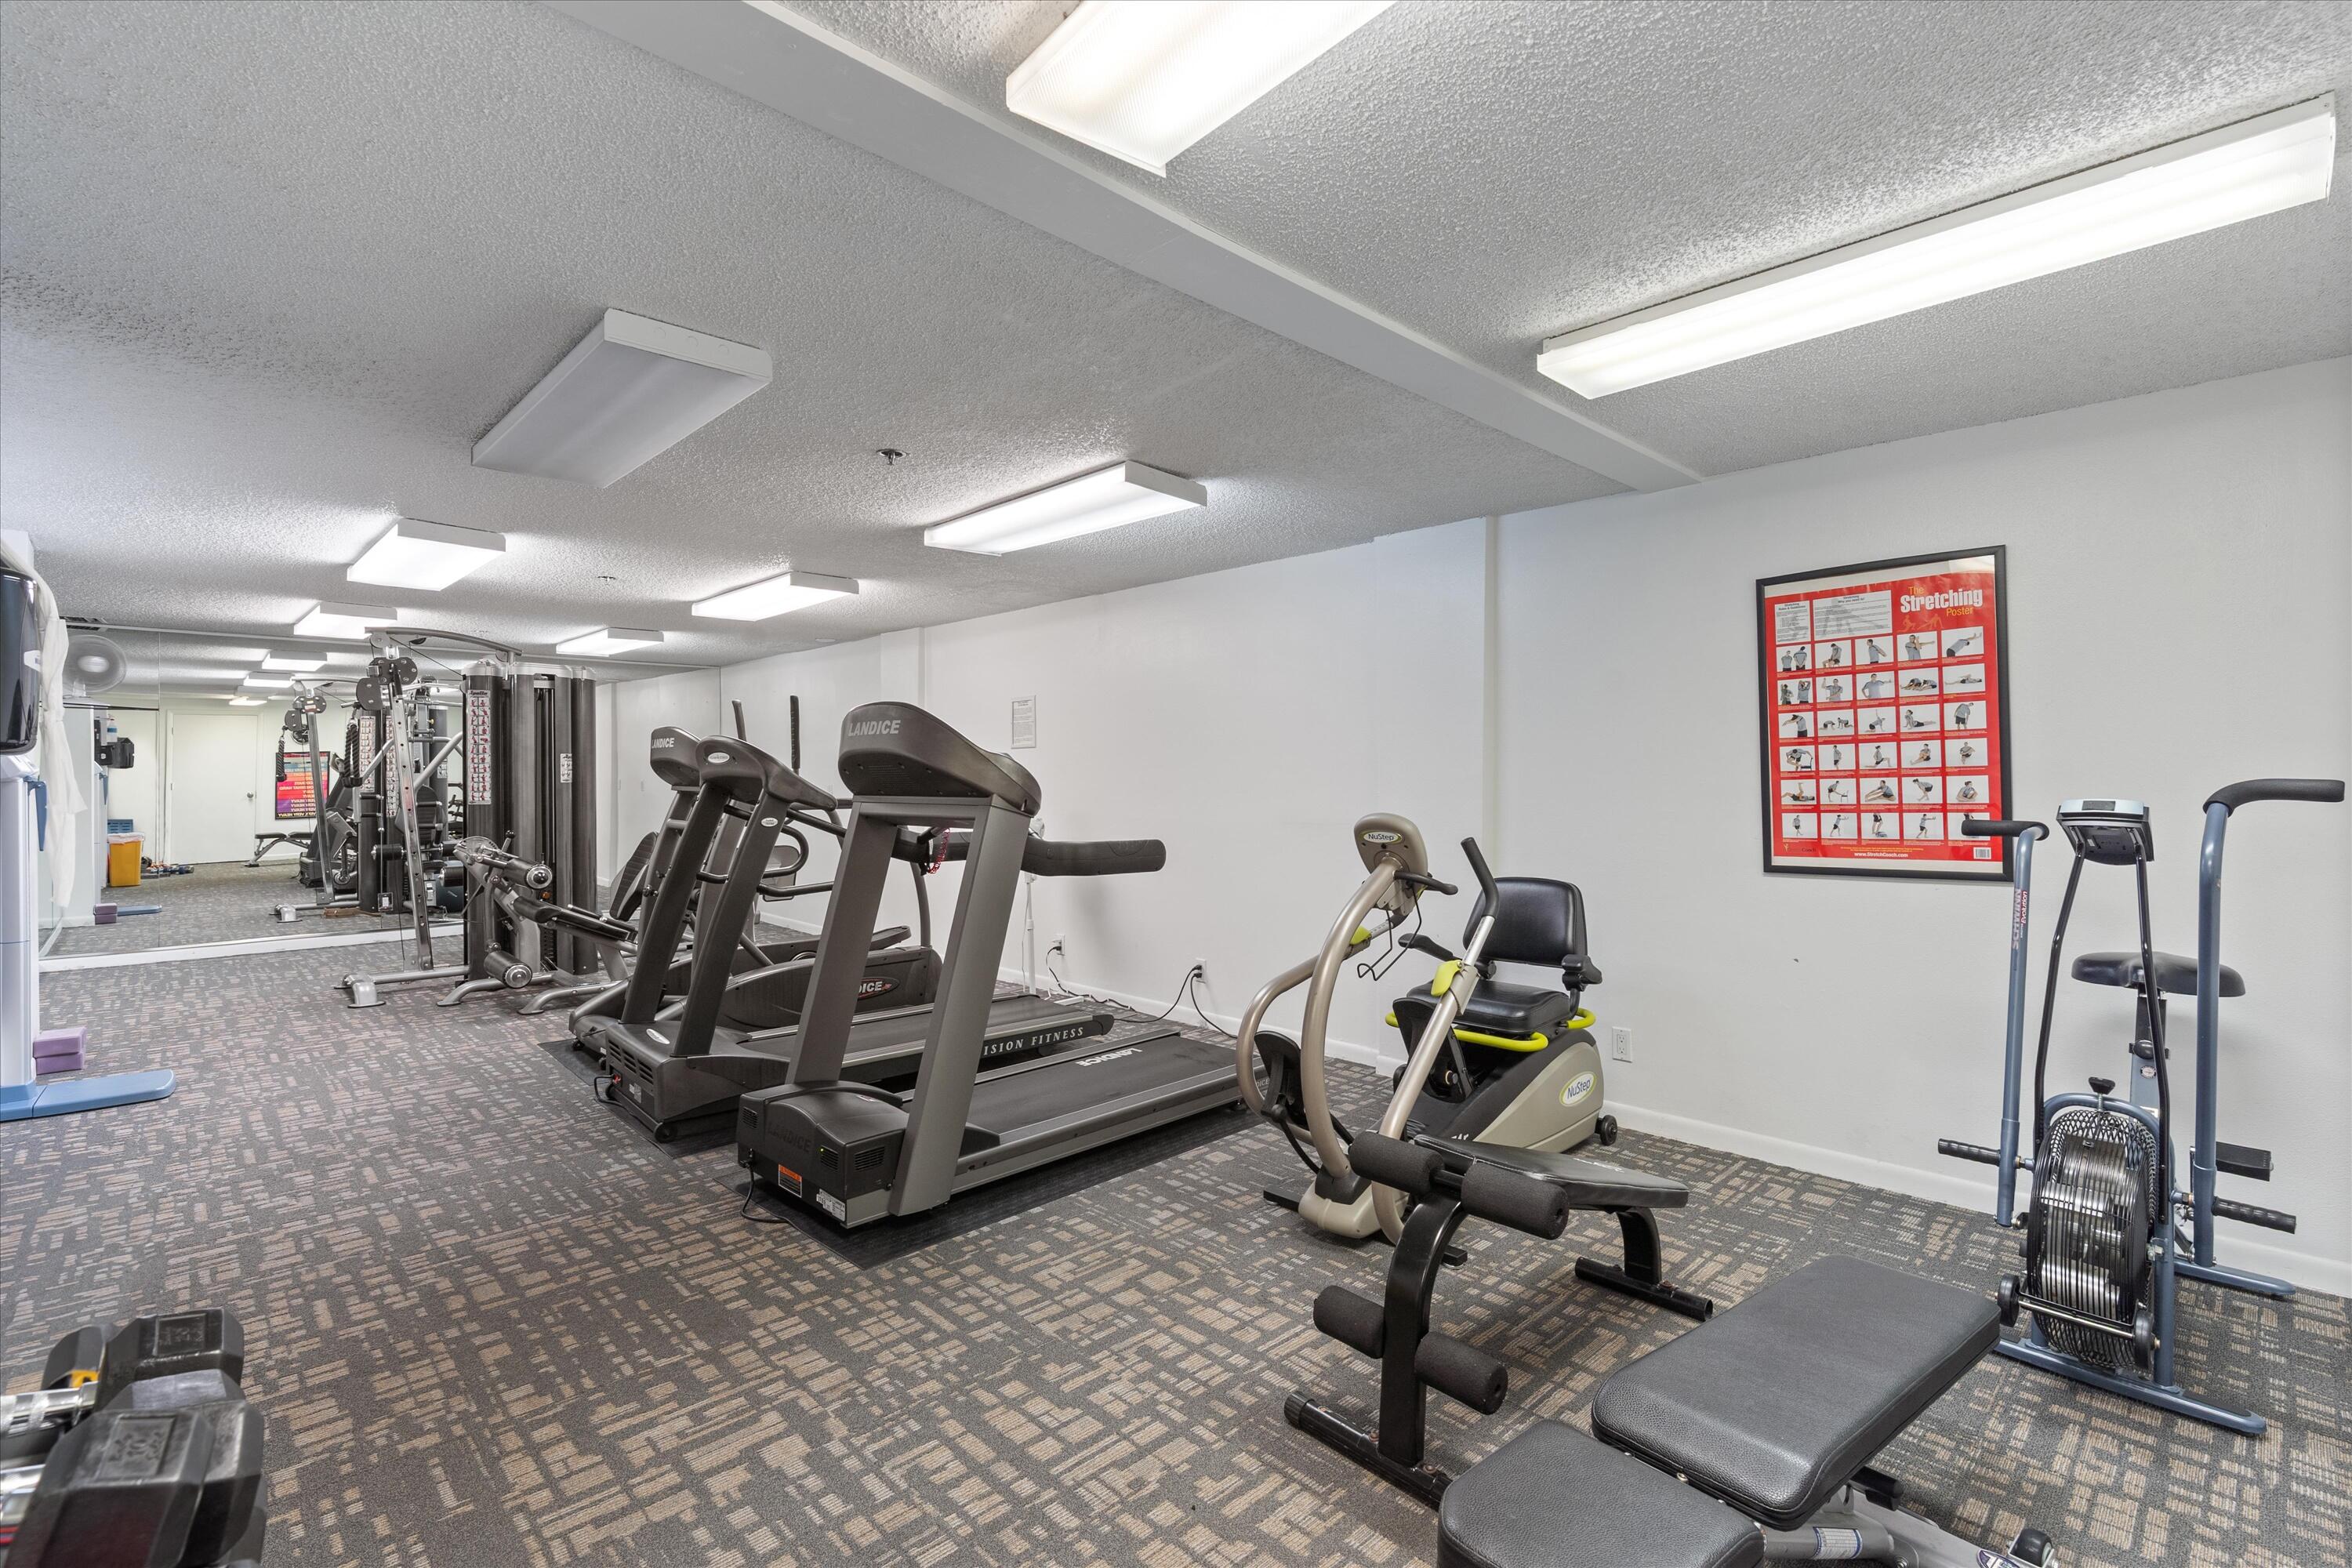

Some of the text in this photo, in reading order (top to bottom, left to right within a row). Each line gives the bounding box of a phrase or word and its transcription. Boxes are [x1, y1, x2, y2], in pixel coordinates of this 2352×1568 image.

[1907, 586, 1925, 595] The
[1900, 588, 1984, 613] Stretching
[1946, 607, 1974, 617] Poster
[848, 720, 902, 737] LANDICE
[652, 737, 675, 749] LANDICE
[2013, 888, 2021, 950] SCHWINN
[1031, 1027, 1084, 1046] FITNESS
[1075, 1047, 1142, 1067] LANDICE
[1567, 1079, 1591, 1099] NuStep
